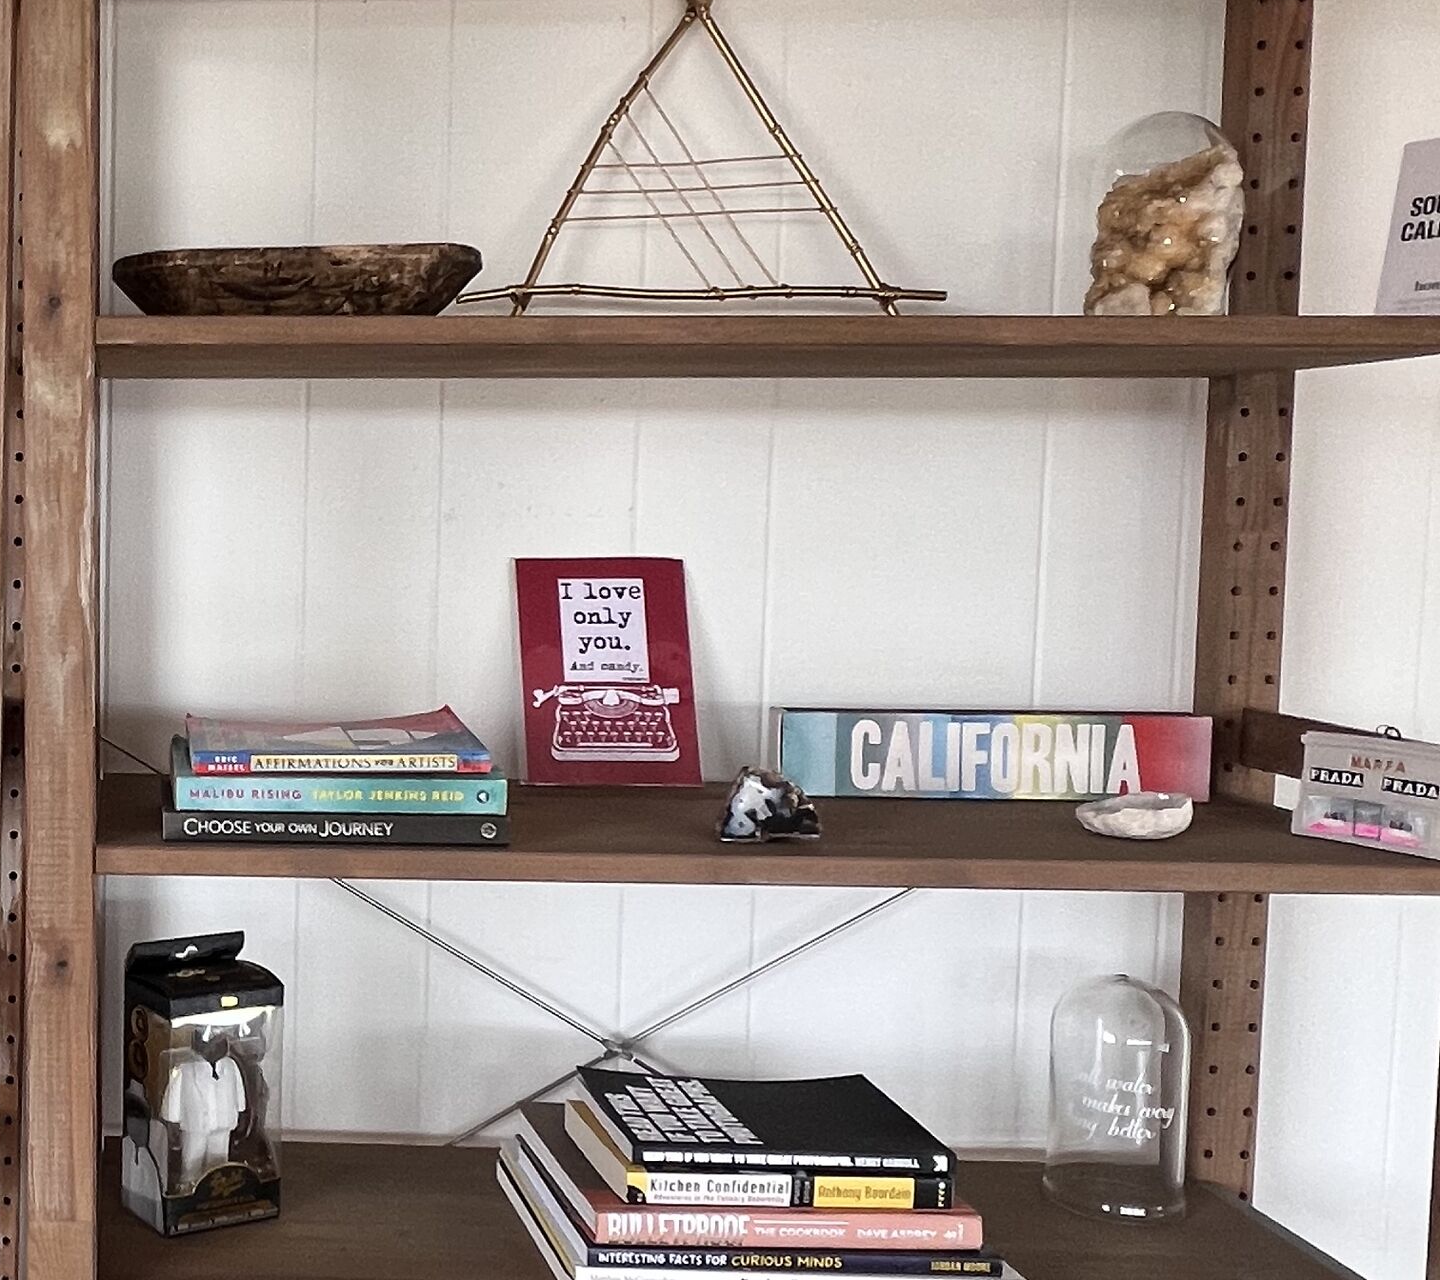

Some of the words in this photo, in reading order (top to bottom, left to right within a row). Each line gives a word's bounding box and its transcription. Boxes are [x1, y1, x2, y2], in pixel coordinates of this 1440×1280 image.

[560, 583, 574, 600] I
[584, 582, 642, 600] love
[573, 607, 632, 628] only
[578, 635, 631, 654] you.
[570, 661, 594, 671] And
[214, 755, 238, 764] ERIC
[254, 758, 372, 769] AFFIRMATIONS
[397, 757, 456, 768] ARTISTS
[850, 719, 1142, 795] CALIFORNIA
[1350, 756, 1406, 773] MARFA
[1310, 769, 1364, 787] PRADA
[1382, 778, 1439, 798] PRADA
[189, 789, 244, 800] MALIBU
[251, 789, 302, 800] RISING
[313, 789, 363, 801] TAYLOR
[368, 790, 427, 801] JENKINS
[431, 790, 465, 801] REID
[183, 818, 252, 836] CHOOSE
[254, 822, 286, 833] YOUR
[288, 823, 318, 834] OWN
[318, 820, 394, 837] JOURNEY
[649, 1179, 700, 1192] Kitchen
[707, 1179, 789, 1194] Confidential
[818, 1185, 861, 1201] Anthony
[864, 1186, 910, 1199] Bourdain
[753, 1227, 776, 1236] THE
[779, 1227, 847, 1238] COOKBOOK
[856, 1228, 888, 1239] DAVE
[598, 1252, 666, 1265] INTERESTING
[669, 1253, 703, 1266] FACTS
[706, 1254, 727, 1266] FOR
[731, 1254, 792, 1267] CURIOUS
[797, 1256, 843, 1268] MINDS
